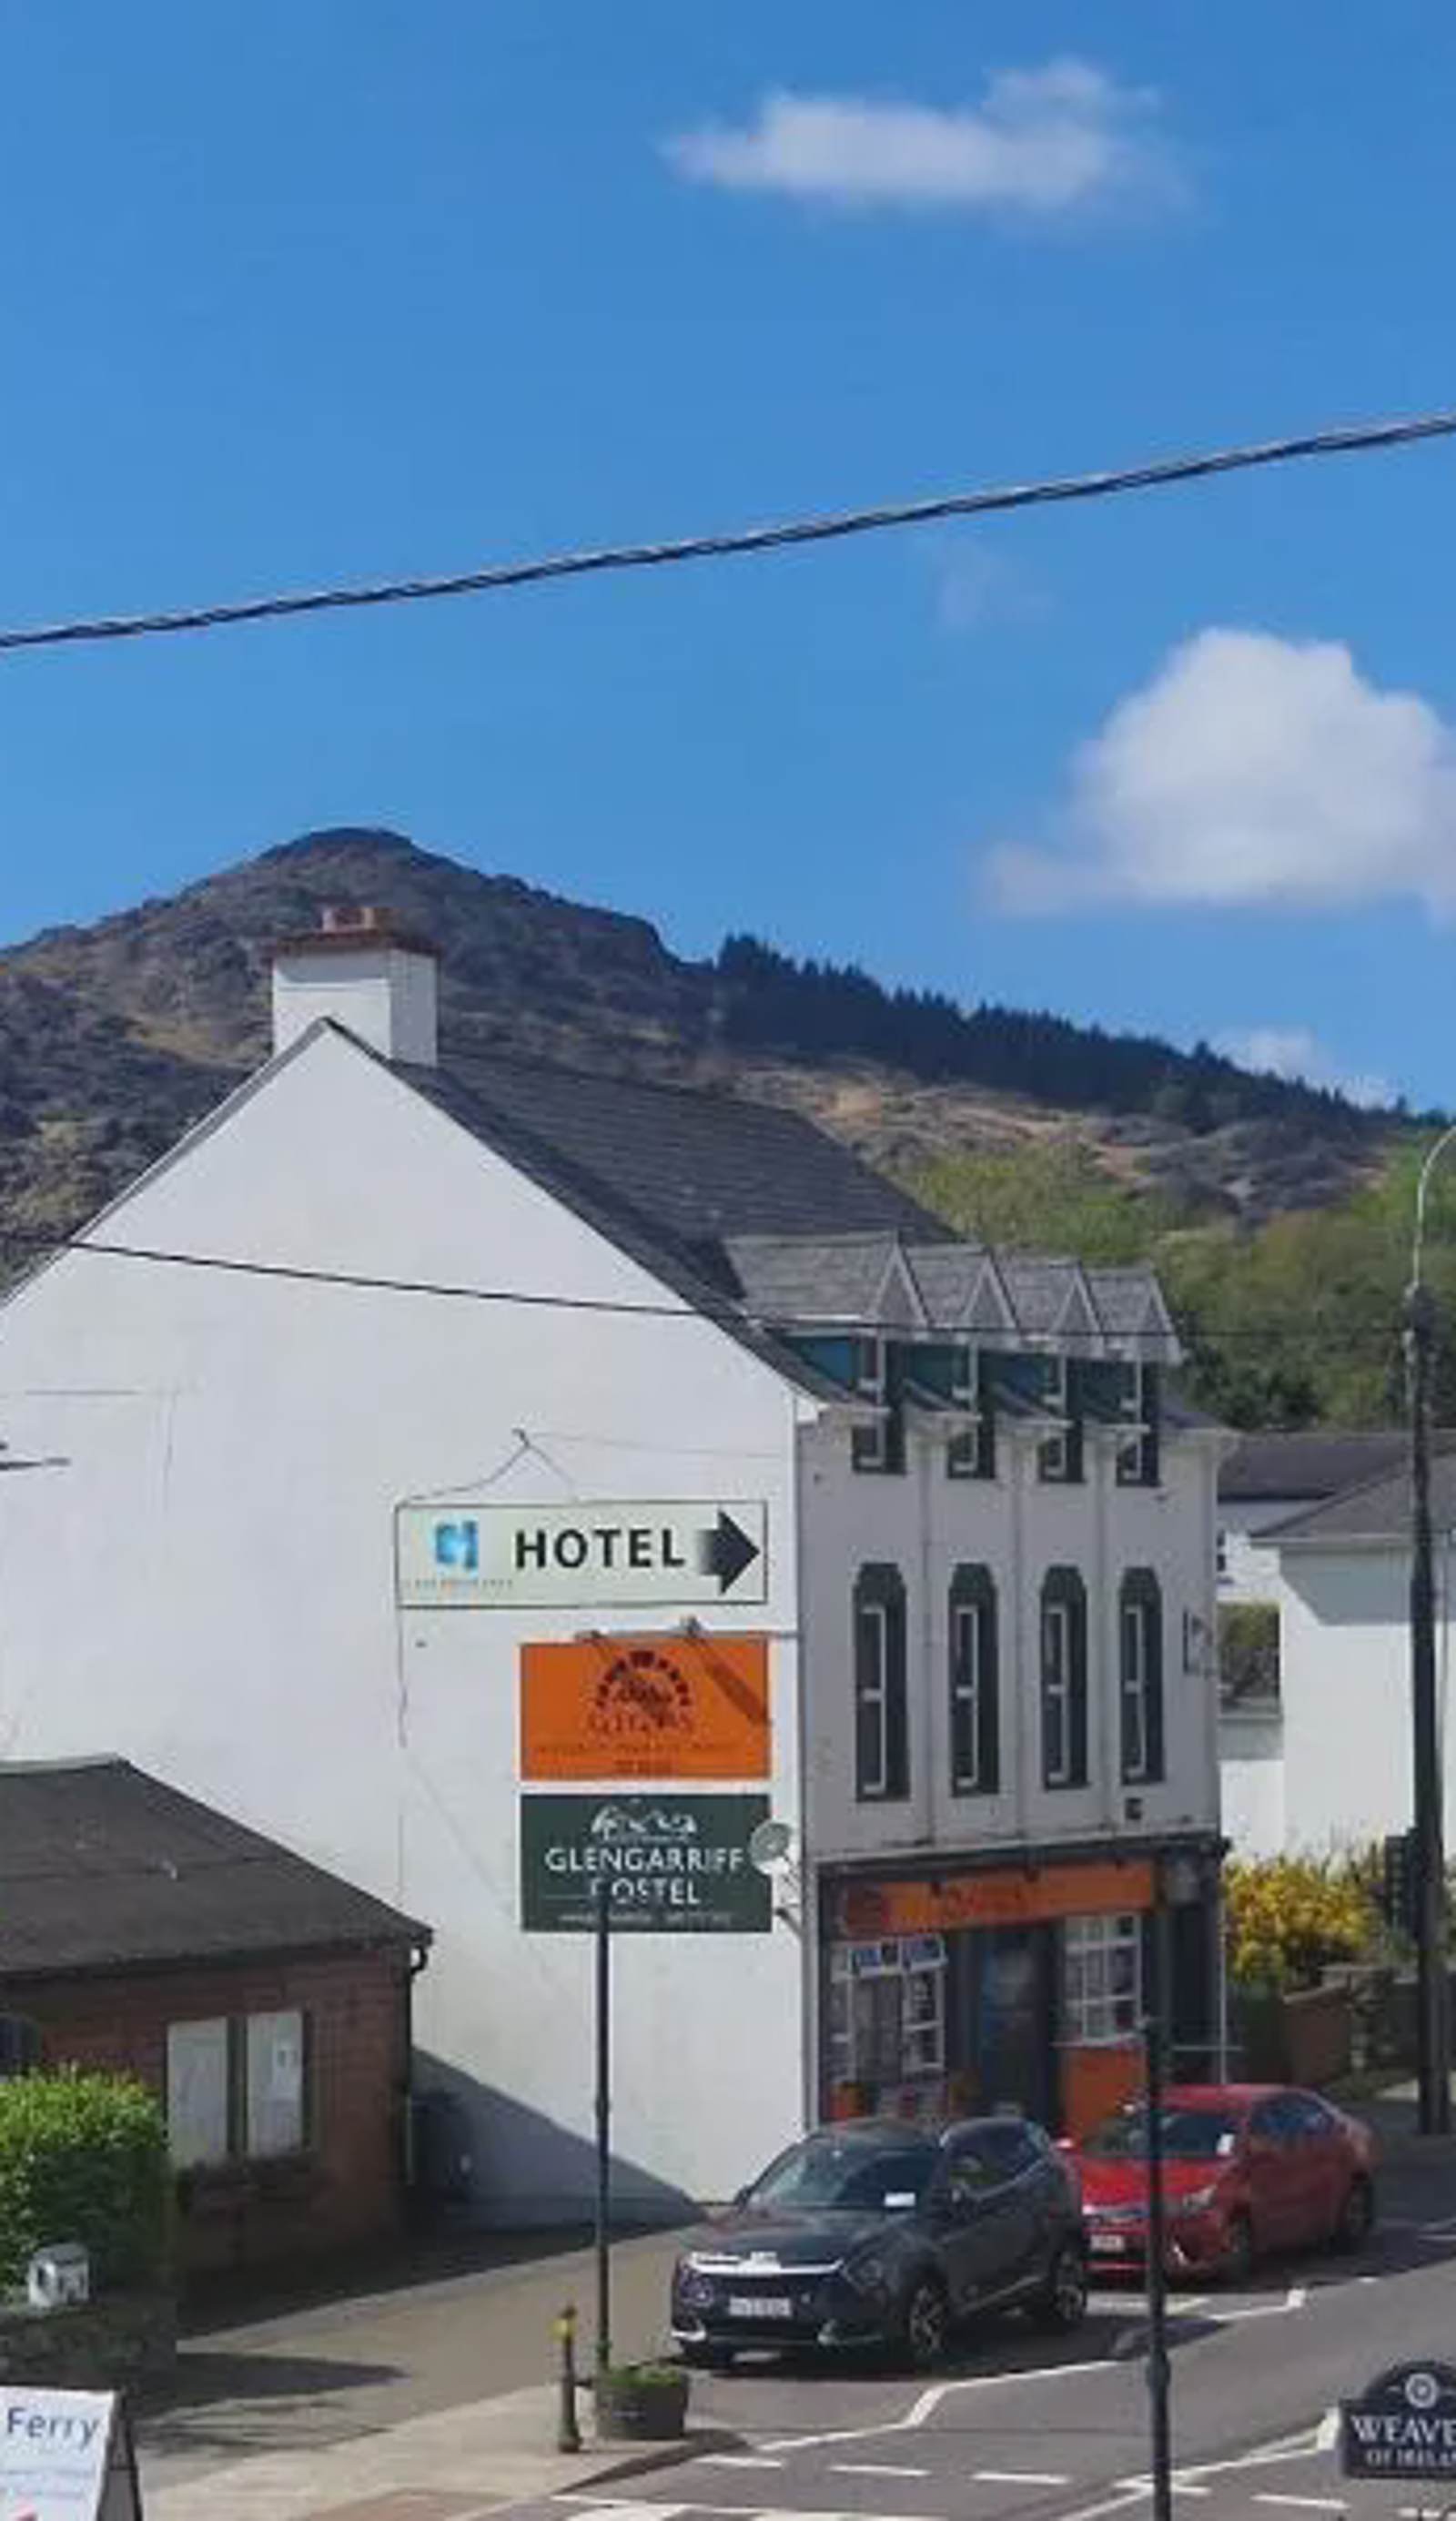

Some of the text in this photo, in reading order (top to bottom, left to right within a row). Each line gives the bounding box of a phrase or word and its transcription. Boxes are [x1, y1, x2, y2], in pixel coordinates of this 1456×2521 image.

[514, 1528, 685, 1569] HOTEL
[544, 1847, 744, 1872] GLENGARRIFF
[7, 2405, 99, 2449] Ferry
[1365, 2448, 1391, 2467] OF
